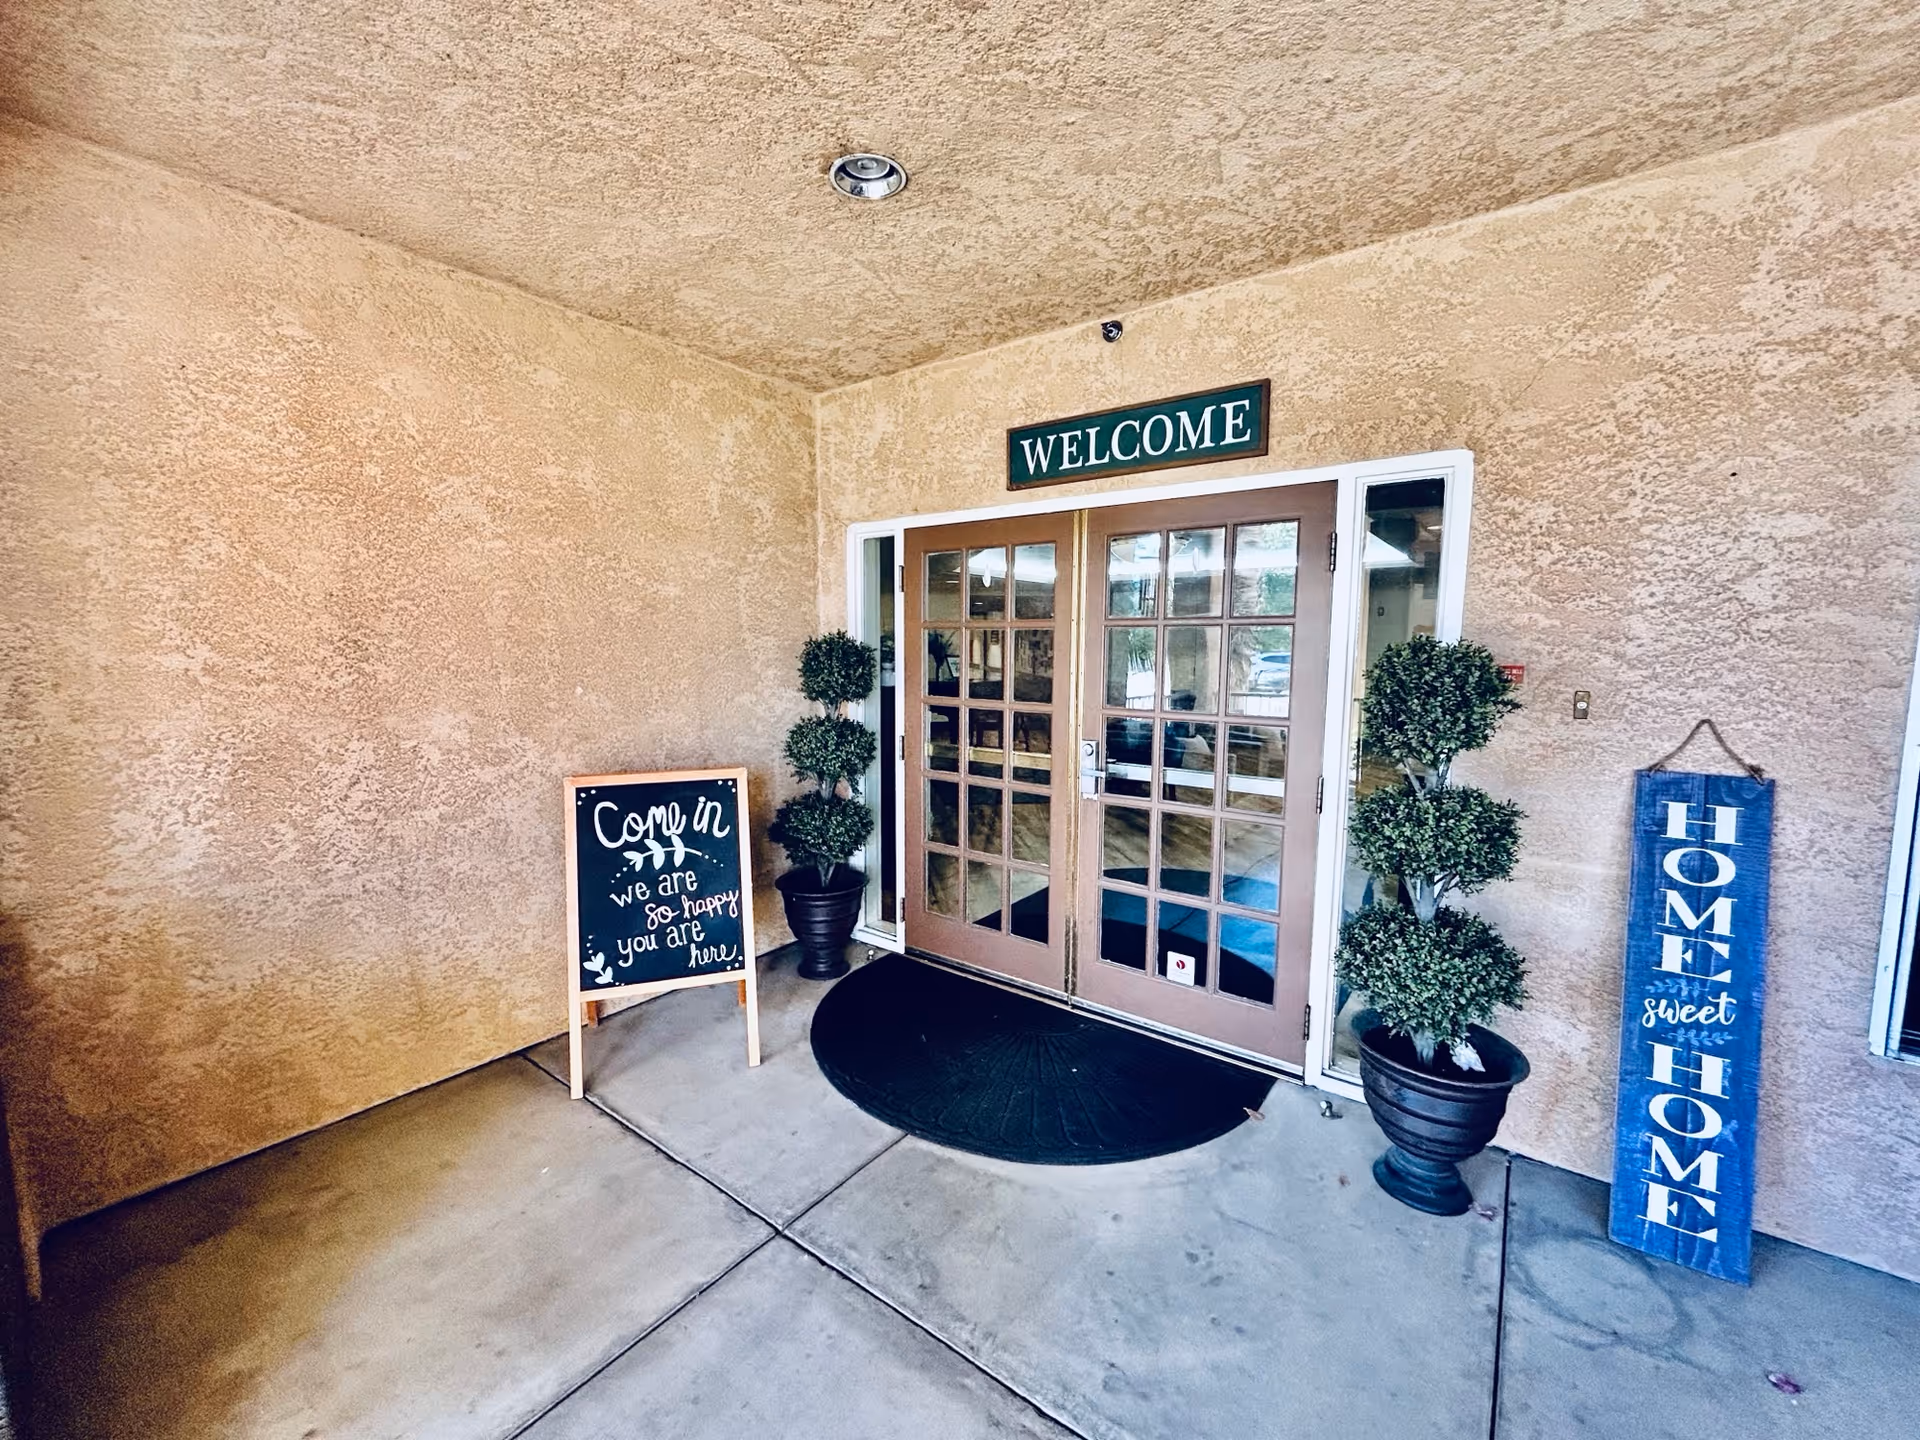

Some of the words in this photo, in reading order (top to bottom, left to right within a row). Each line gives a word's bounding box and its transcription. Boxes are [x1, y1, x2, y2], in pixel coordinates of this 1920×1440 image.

[1020, 399, 1251, 475] WELCOME
[594, 801, 686, 848] Come
[693, 796, 730, 838] in
[609, 881, 650, 908] we
[658, 870, 698, 896] are
[645, 903, 680, 930] so
[681, 889, 739, 919] happy
[1652, 801, 1745, 984] HOME
[617, 933, 658, 968] you
[666, 920, 705, 948] are
[689, 943, 737, 968] here
[1641, 991, 1737, 1028] sweet
[1637, 1041, 1731, 1243] HOME
